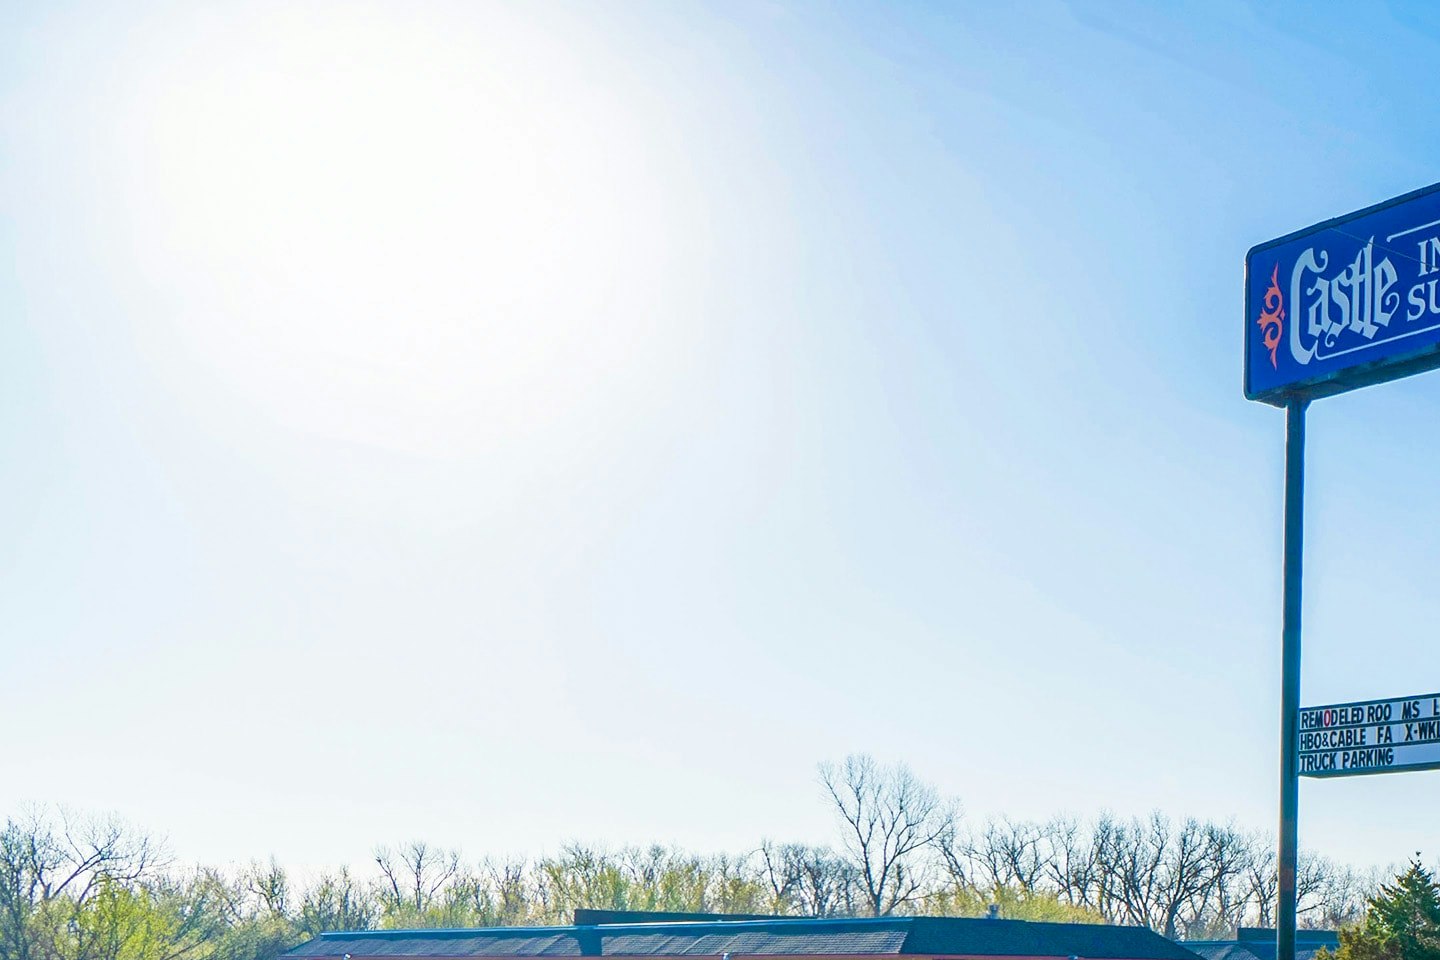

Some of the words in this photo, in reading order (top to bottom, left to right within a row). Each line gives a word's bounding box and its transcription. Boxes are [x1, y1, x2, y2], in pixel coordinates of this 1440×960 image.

[1290, 235, 1400, 365] Castle
[1301, 707, 1364, 728] REMODELED
[1367, 703, 1392, 723] ROO
[1402, 700, 1420, 720] MS
[1300, 728, 1366, 751] HBO&CABLE
[1377, 725, 1393, 744] FA
[1300, 752, 1337, 772] TRUCK
[1341, 747, 1394, 769] PARKING
